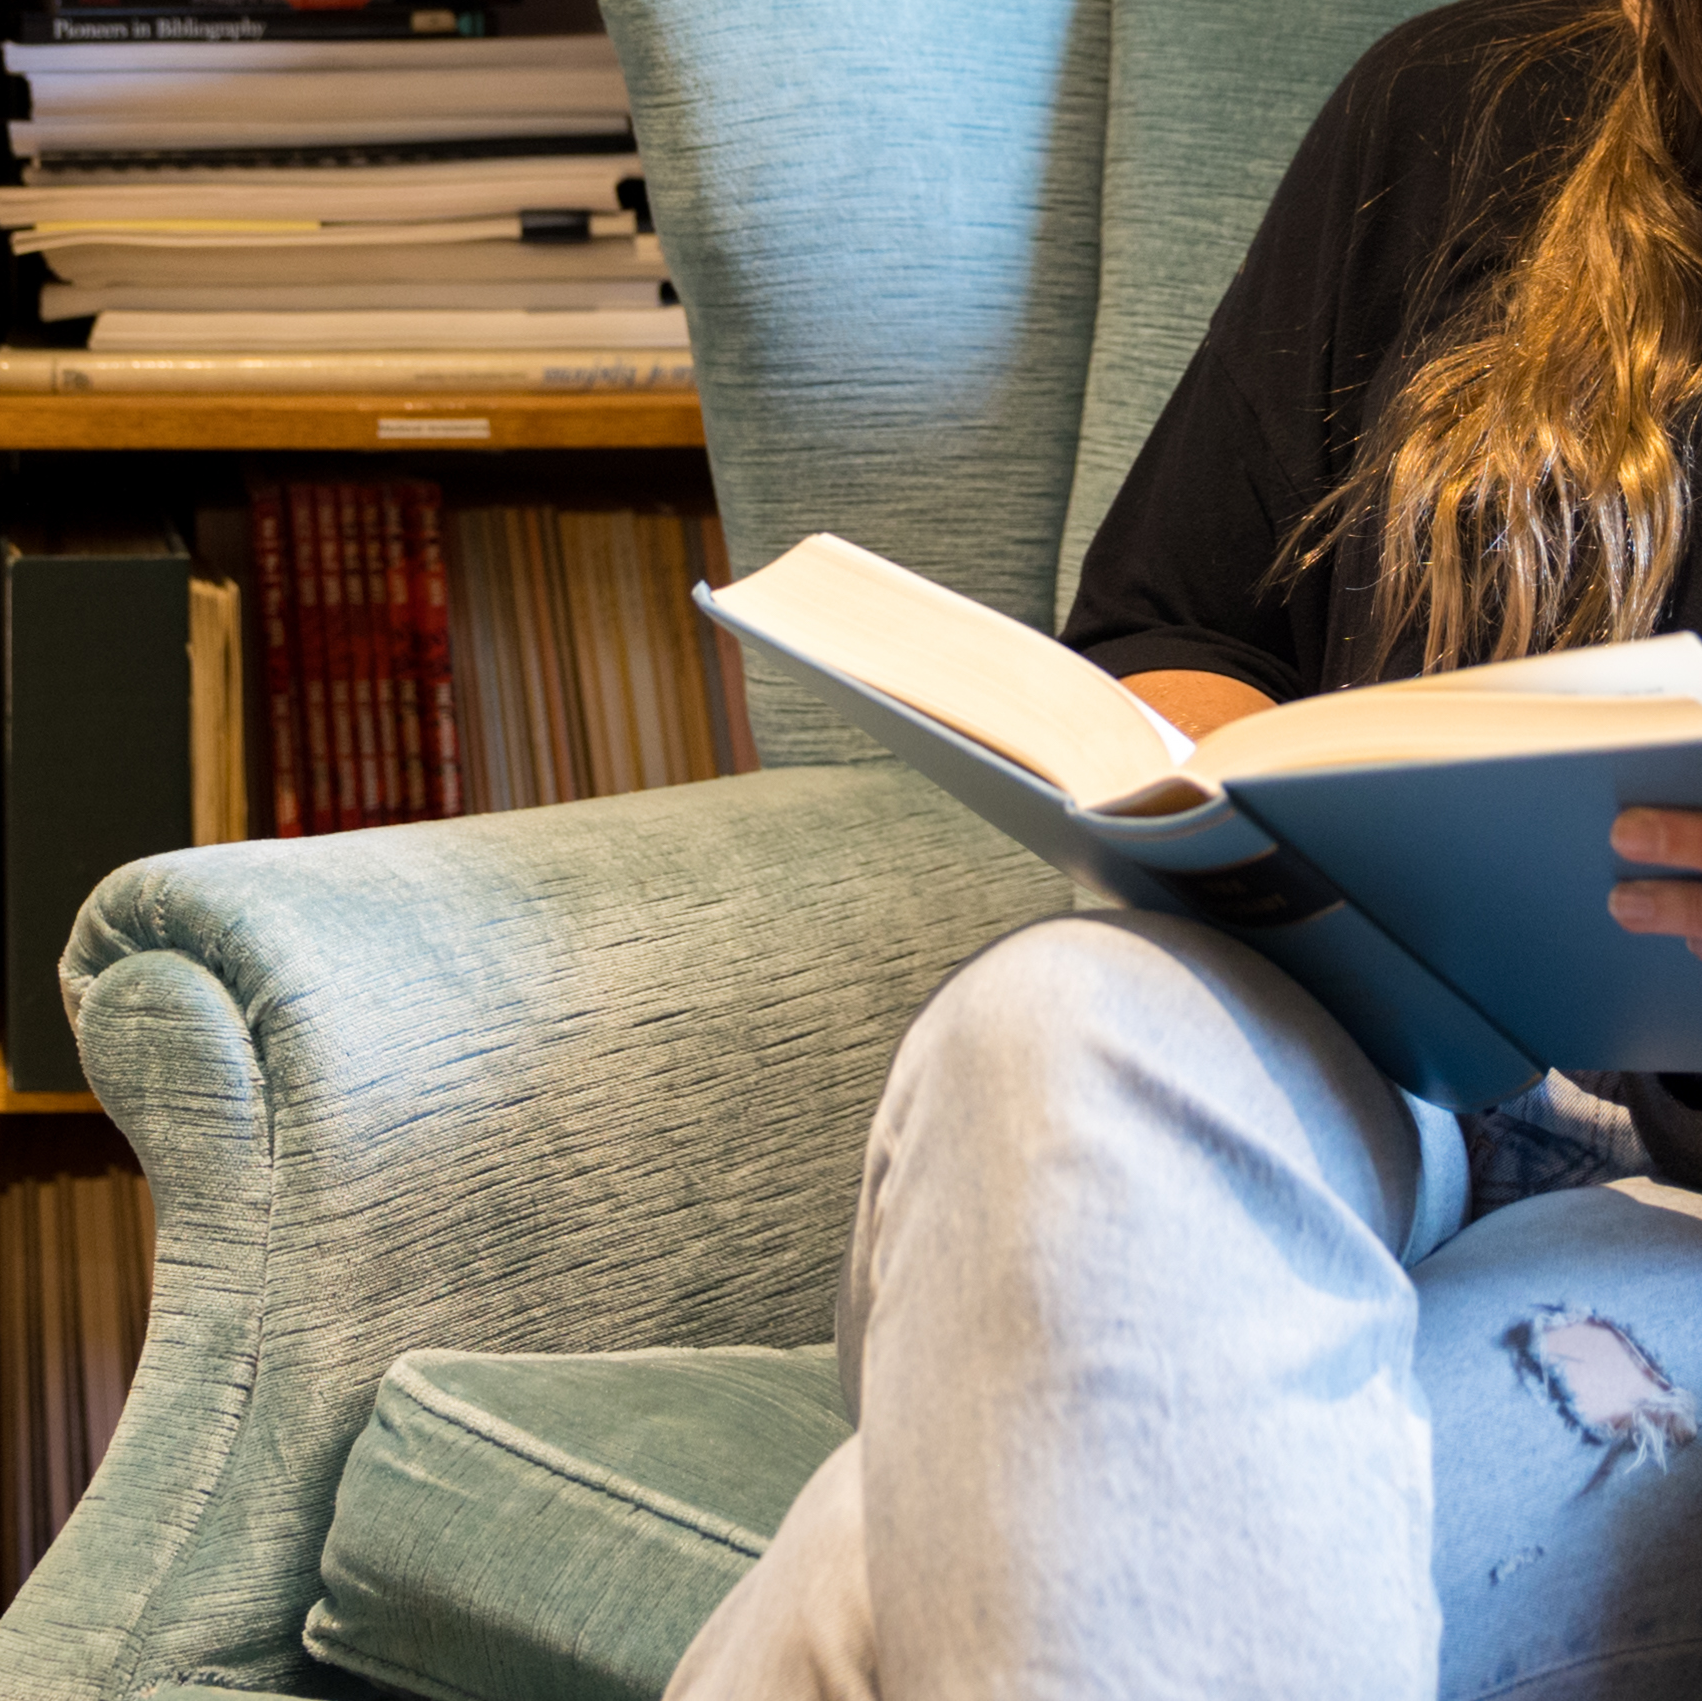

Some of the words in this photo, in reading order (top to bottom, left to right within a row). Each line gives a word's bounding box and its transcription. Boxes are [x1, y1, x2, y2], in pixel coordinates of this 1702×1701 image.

[53, 17, 128, 40] Pioneers
[131, 16, 152, 39] in
[156, 16, 267, 42] Bibliography
